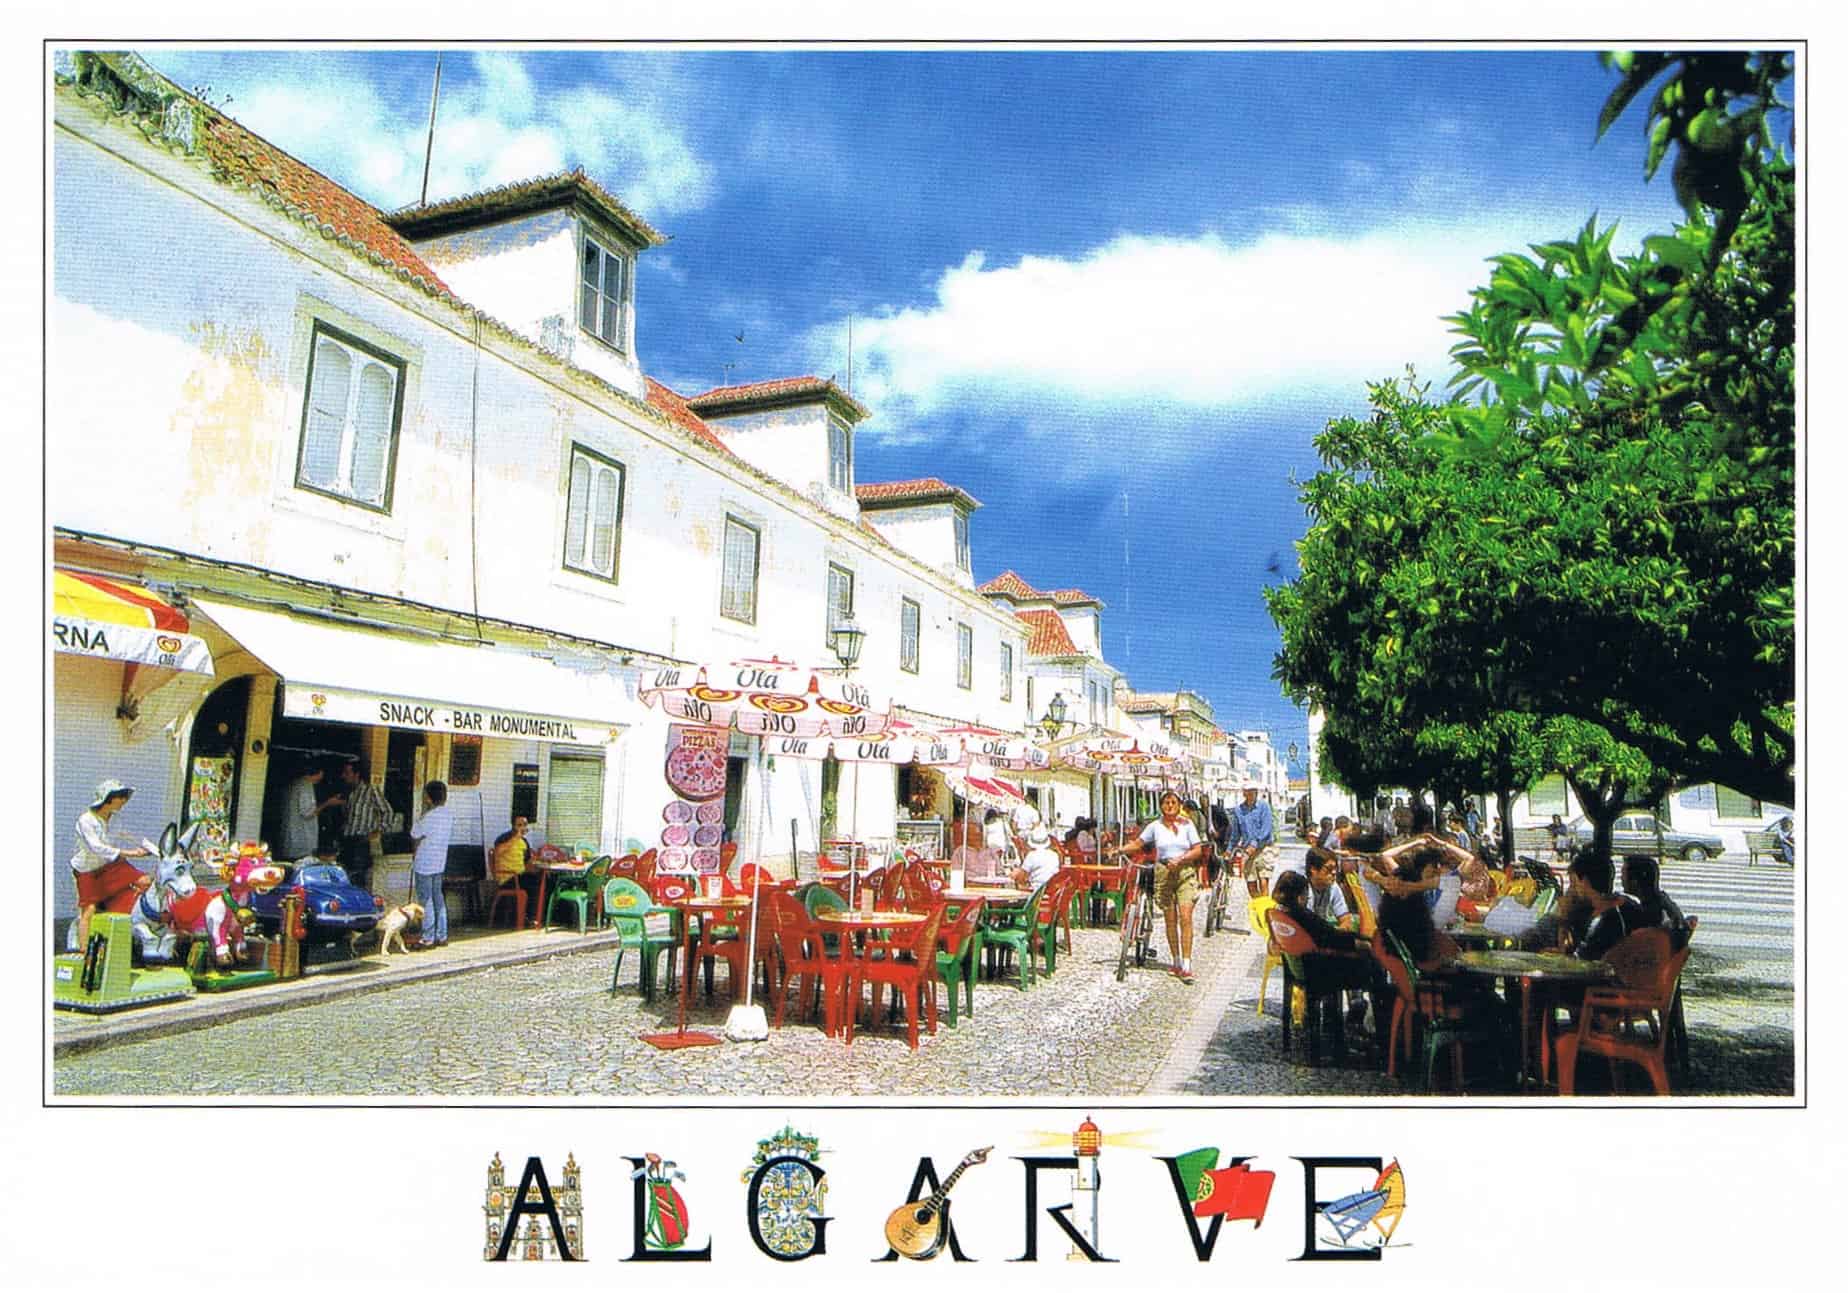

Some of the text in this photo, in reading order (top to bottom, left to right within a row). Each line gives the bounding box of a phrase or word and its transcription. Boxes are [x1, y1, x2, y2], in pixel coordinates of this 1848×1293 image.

[379, 702, 435, 727] SNACK
[453, 710, 483, 731] BAR
[489, 715, 578, 741] MONUMENTAL
[682, 735, 716, 748] PIZZAS
